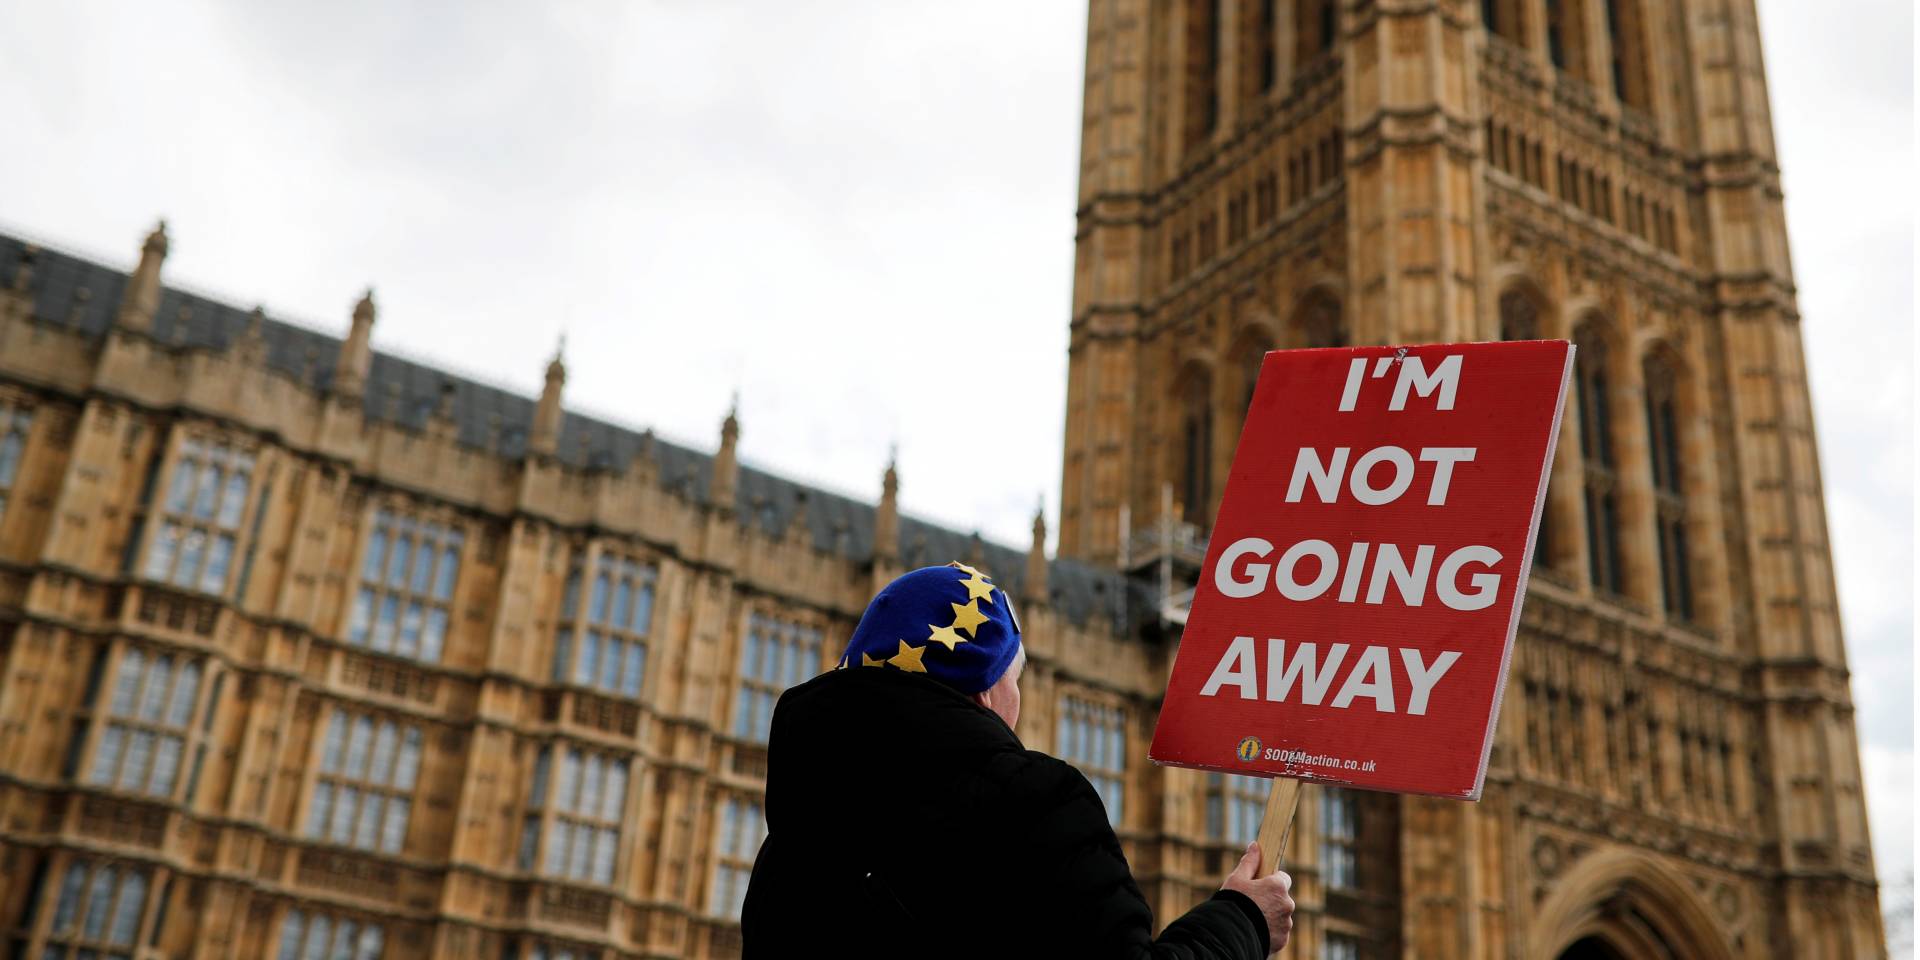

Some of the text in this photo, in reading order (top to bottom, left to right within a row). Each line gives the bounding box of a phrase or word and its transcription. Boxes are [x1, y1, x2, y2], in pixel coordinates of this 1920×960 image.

[1338, 355, 1464, 412] I'M
[1284, 445, 1477, 506] NOT
[1214, 537, 1504, 611] GOING
[1199, 636, 1463, 716] AWAY
